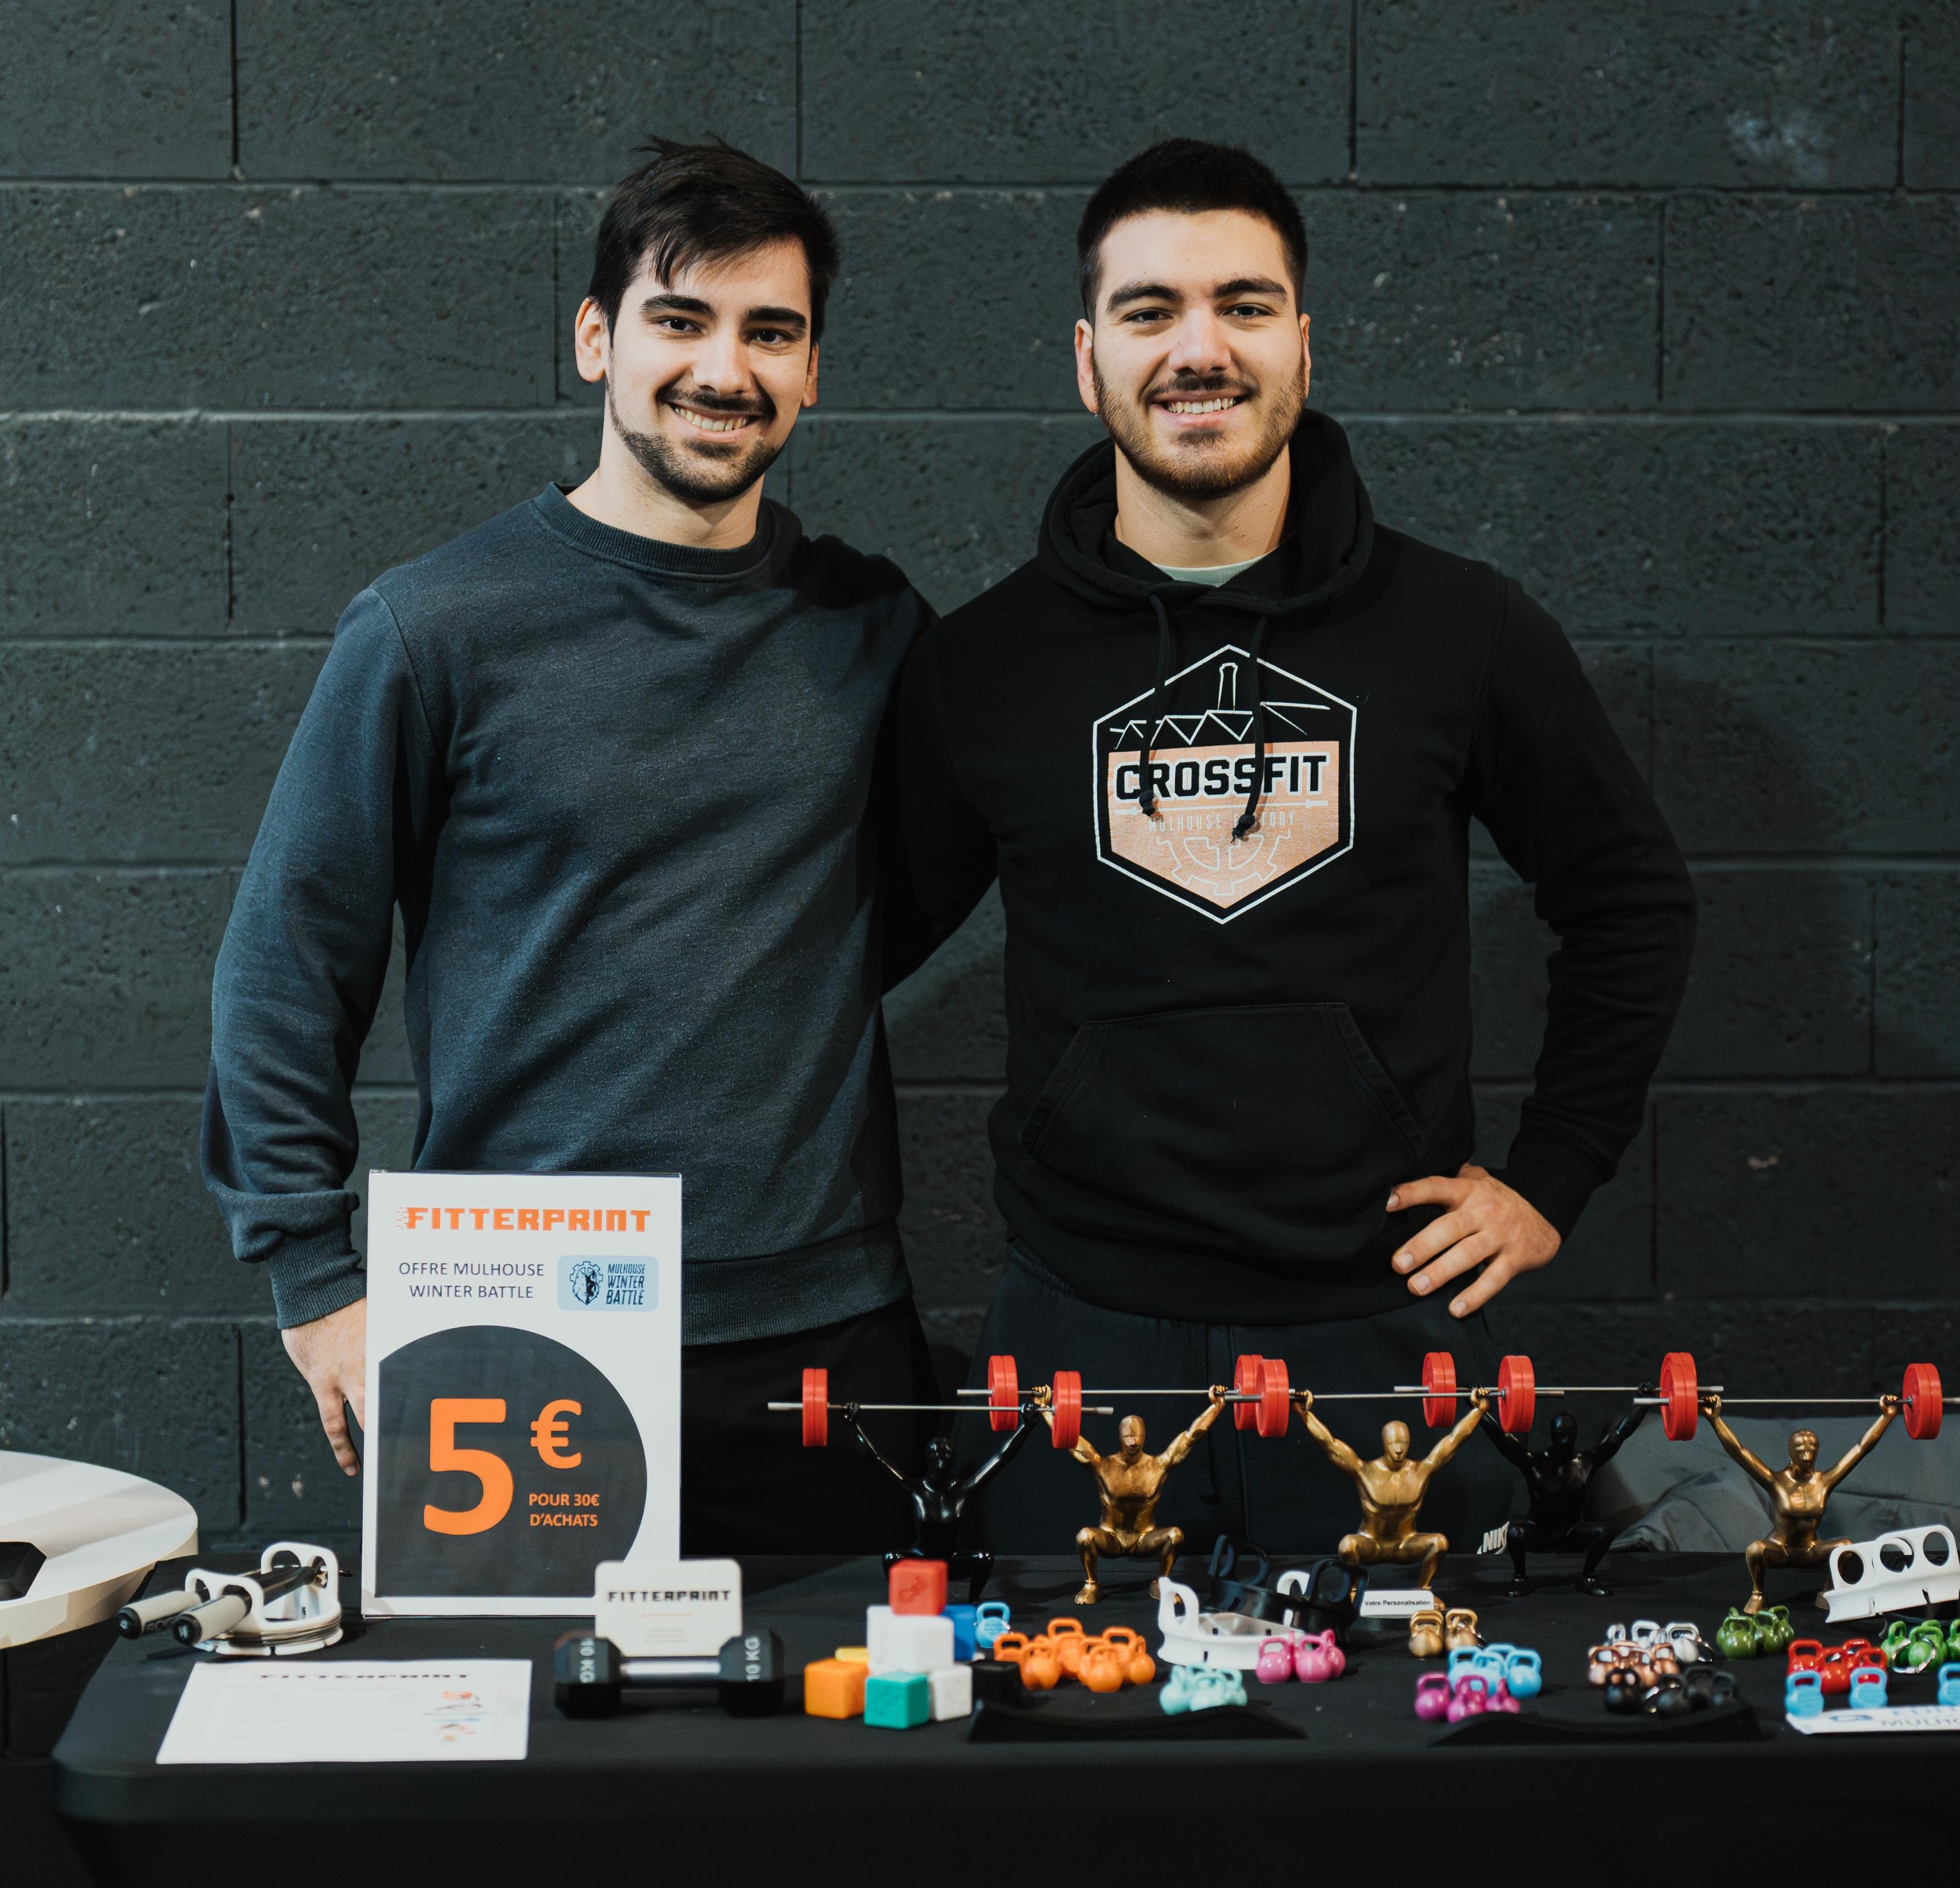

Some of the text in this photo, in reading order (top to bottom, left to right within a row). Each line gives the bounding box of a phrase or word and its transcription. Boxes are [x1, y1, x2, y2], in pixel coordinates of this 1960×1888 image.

[1115, 753, 1329, 801] CROSSFIT
[397, 1207, 651, 1232] FITTERPRINT
[398, 1262, 544, 1277] OFFRE MULHOUSE
[607, 1263, 646, 1274] MULHOUSE
[607, 1275, 644, 1289] WINTER
[409, 1285, 533, 1298] WINTER BATTLE
[606, 1289, 644, 1305] BATTLE
[423, 1398, 582, 1536] 5 €
[529, 1492, 600, 1506] POUR 30€
[530, 1513, 598, 1527] D'ACHATS
[1483, 1521, 1509, 1553] NIK
[607, 1590, 730, 1602] FITTERPRINT
